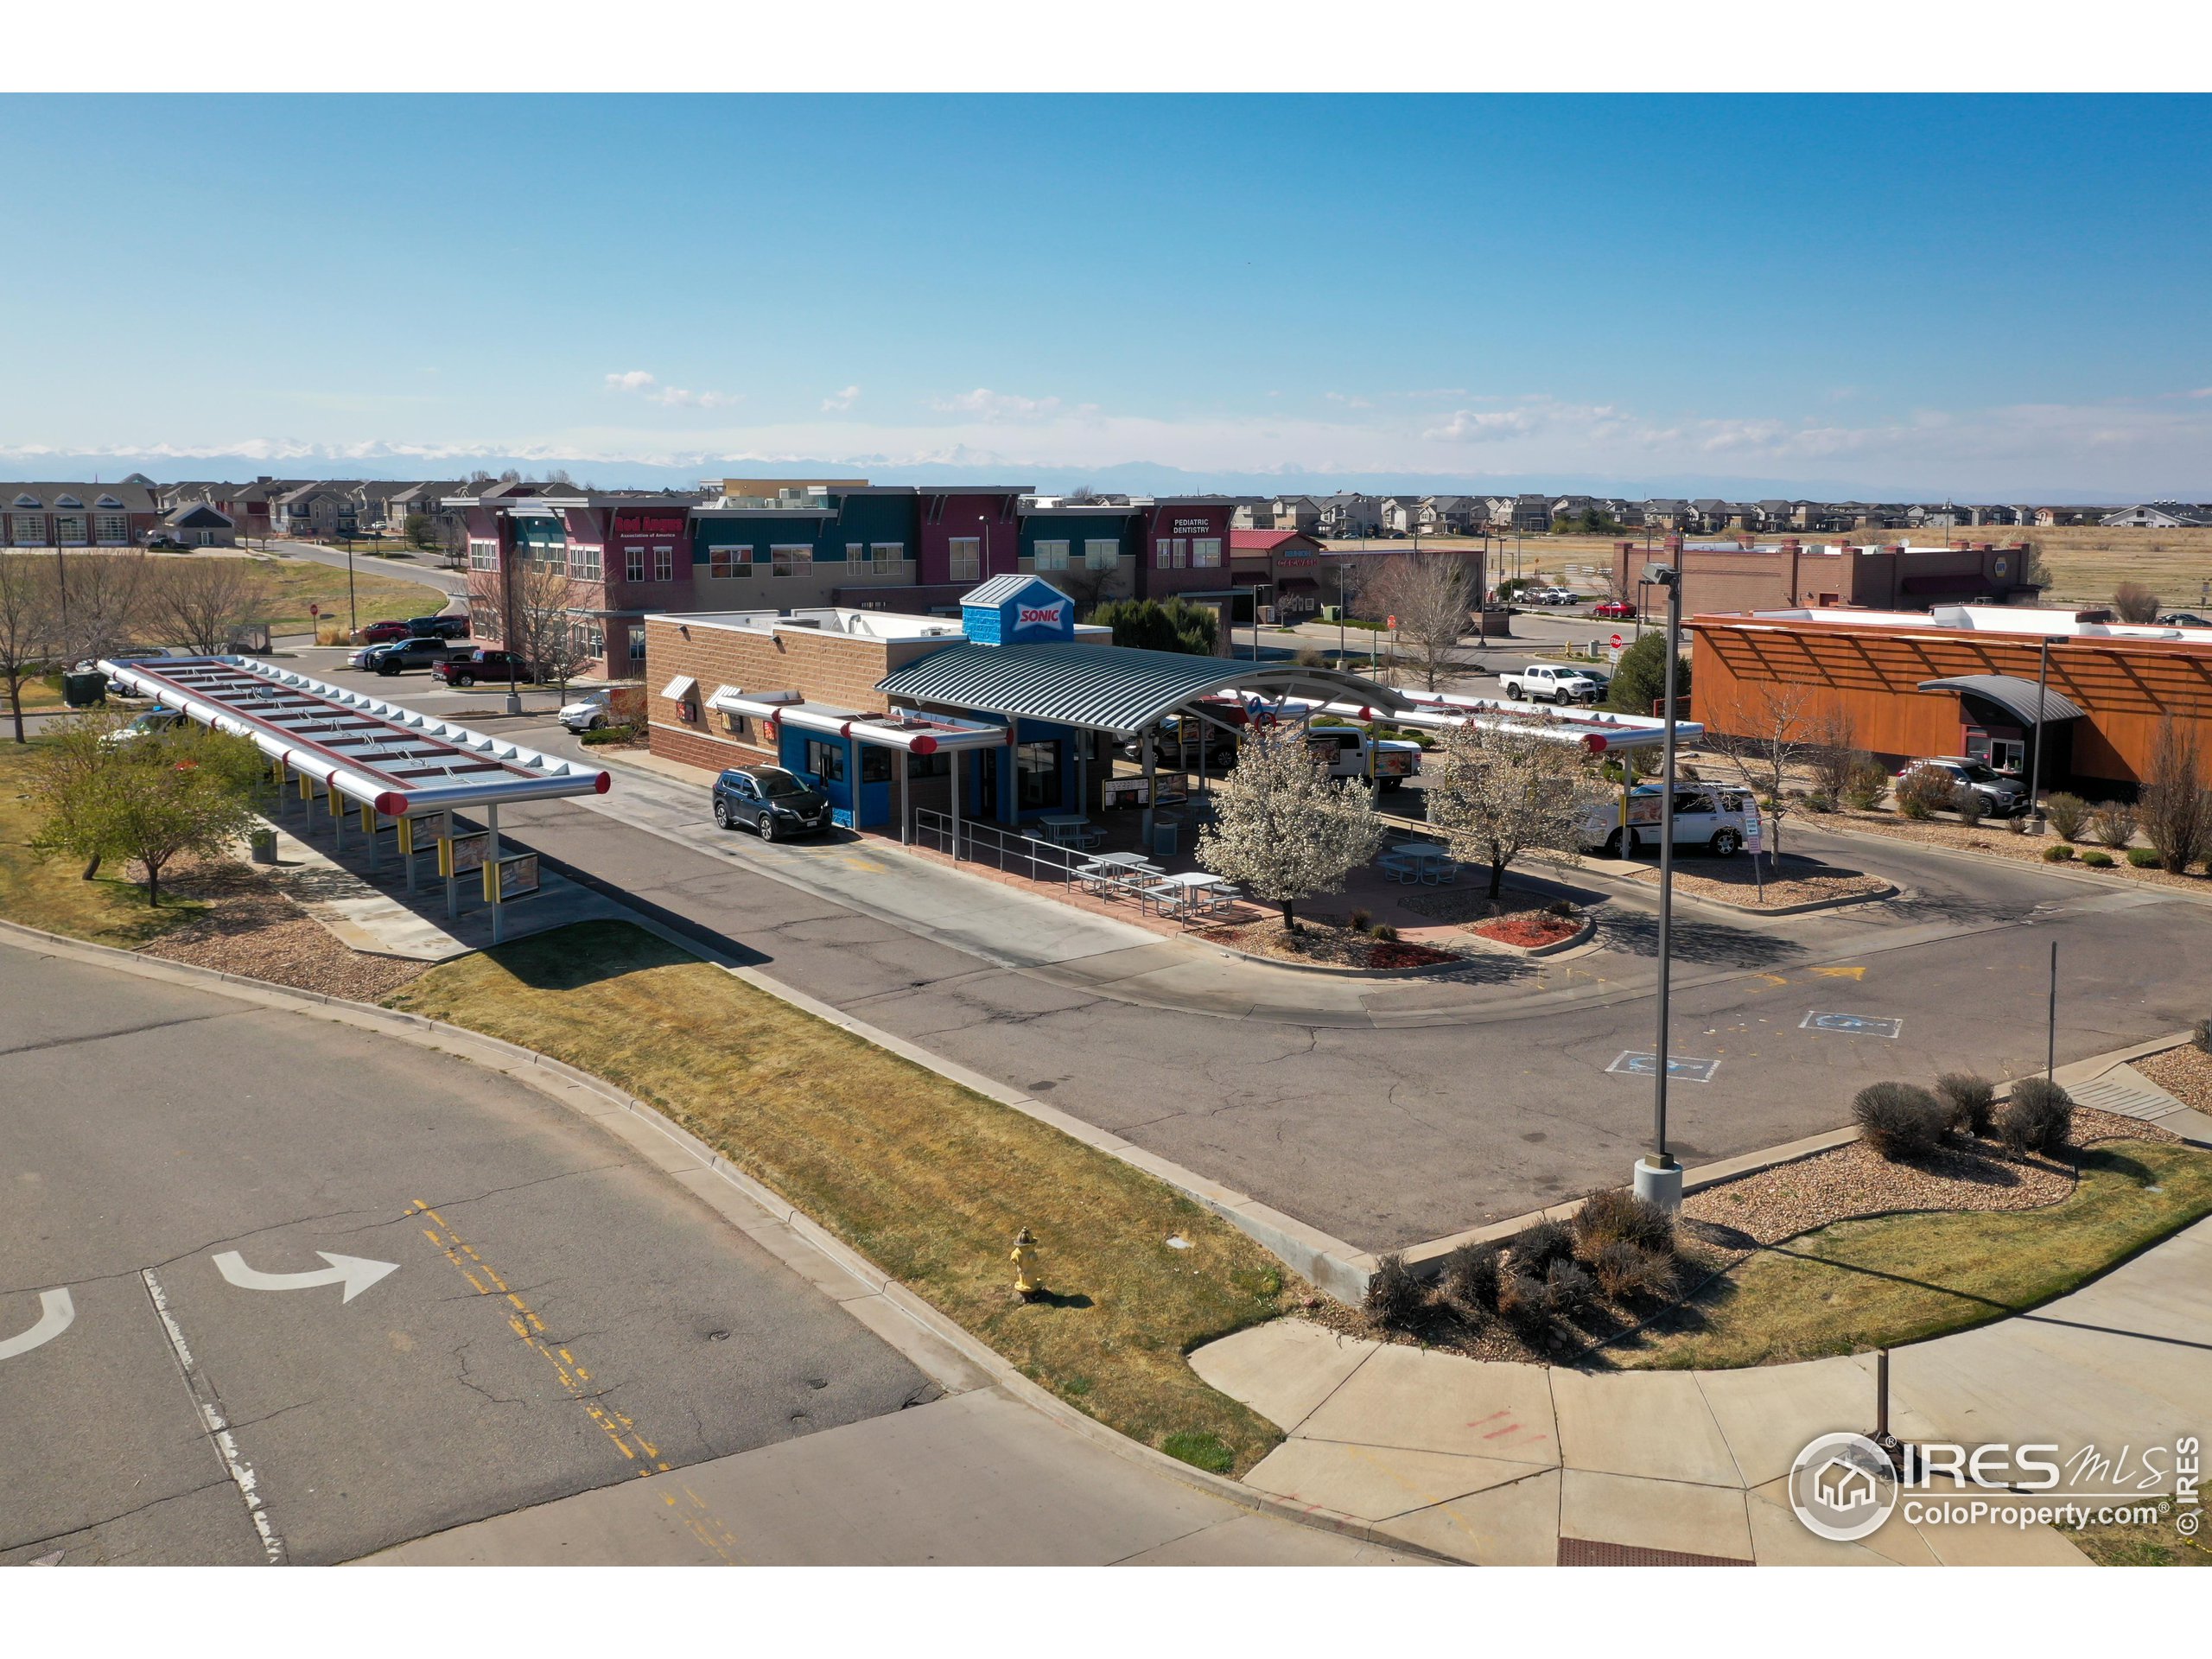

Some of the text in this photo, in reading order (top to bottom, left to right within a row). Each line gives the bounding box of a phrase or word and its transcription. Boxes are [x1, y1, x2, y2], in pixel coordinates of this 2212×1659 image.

[615, 517, 683, 532] Red Angus
[1020, 609, 1059, 622] SONIC
